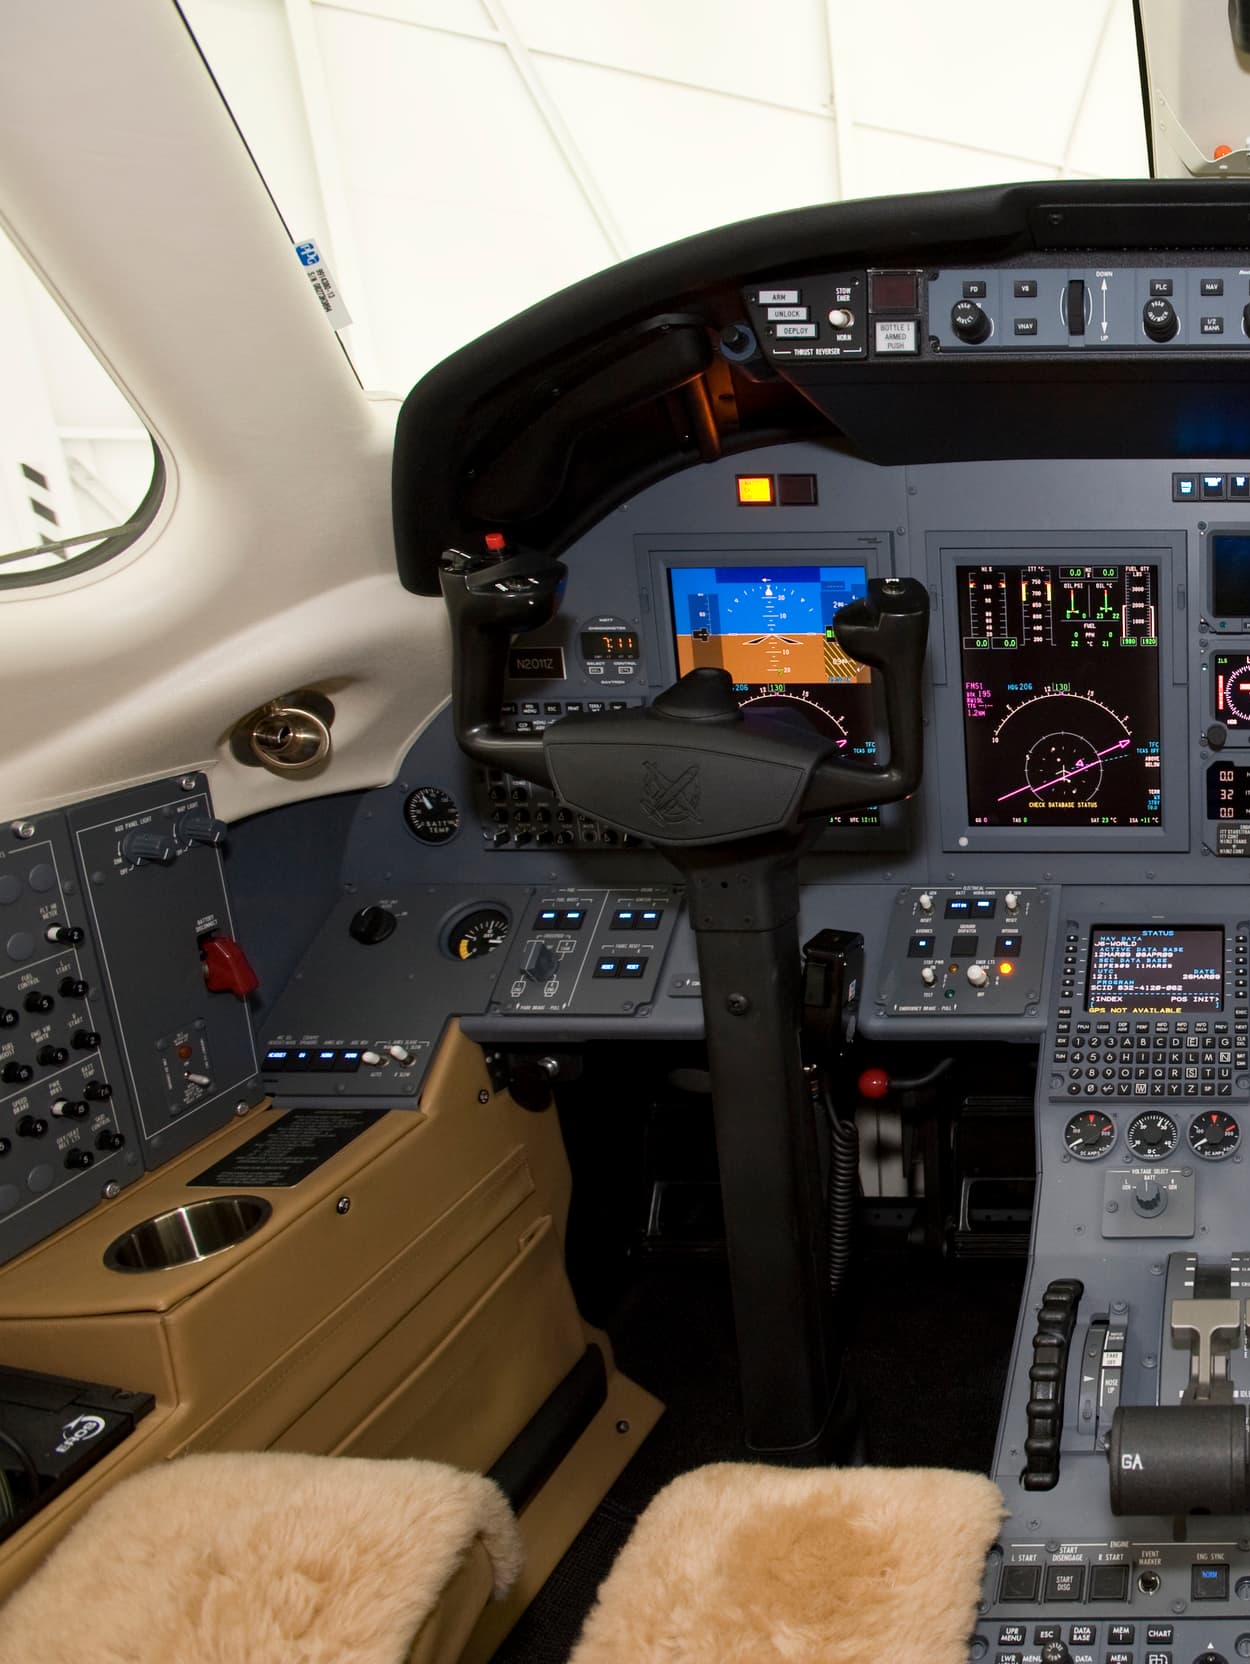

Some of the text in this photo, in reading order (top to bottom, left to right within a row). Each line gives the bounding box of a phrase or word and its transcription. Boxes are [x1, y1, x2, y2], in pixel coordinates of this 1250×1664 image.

[773, 293, 786, 301] ARM
[784, 327, 808, 335] DEPLOY
[794, 348, 814, 356] THRUST
[1220, 771, 1234, 782] 0.0
[1220, 789, 1234, 800] 32
[1220, 808, 1234, 818] 0.0
[1122, 1454, 1143, 1470] GA
[1139, 1558, 1162, 1566] MARKER
[1056, 1576, 1073, 1584] START
[1001, 1634, 1022, 1642] MENU
[1040, 1630, 1054, 1638] ESC
[1148, 1630, 1171, 1638] CHART
